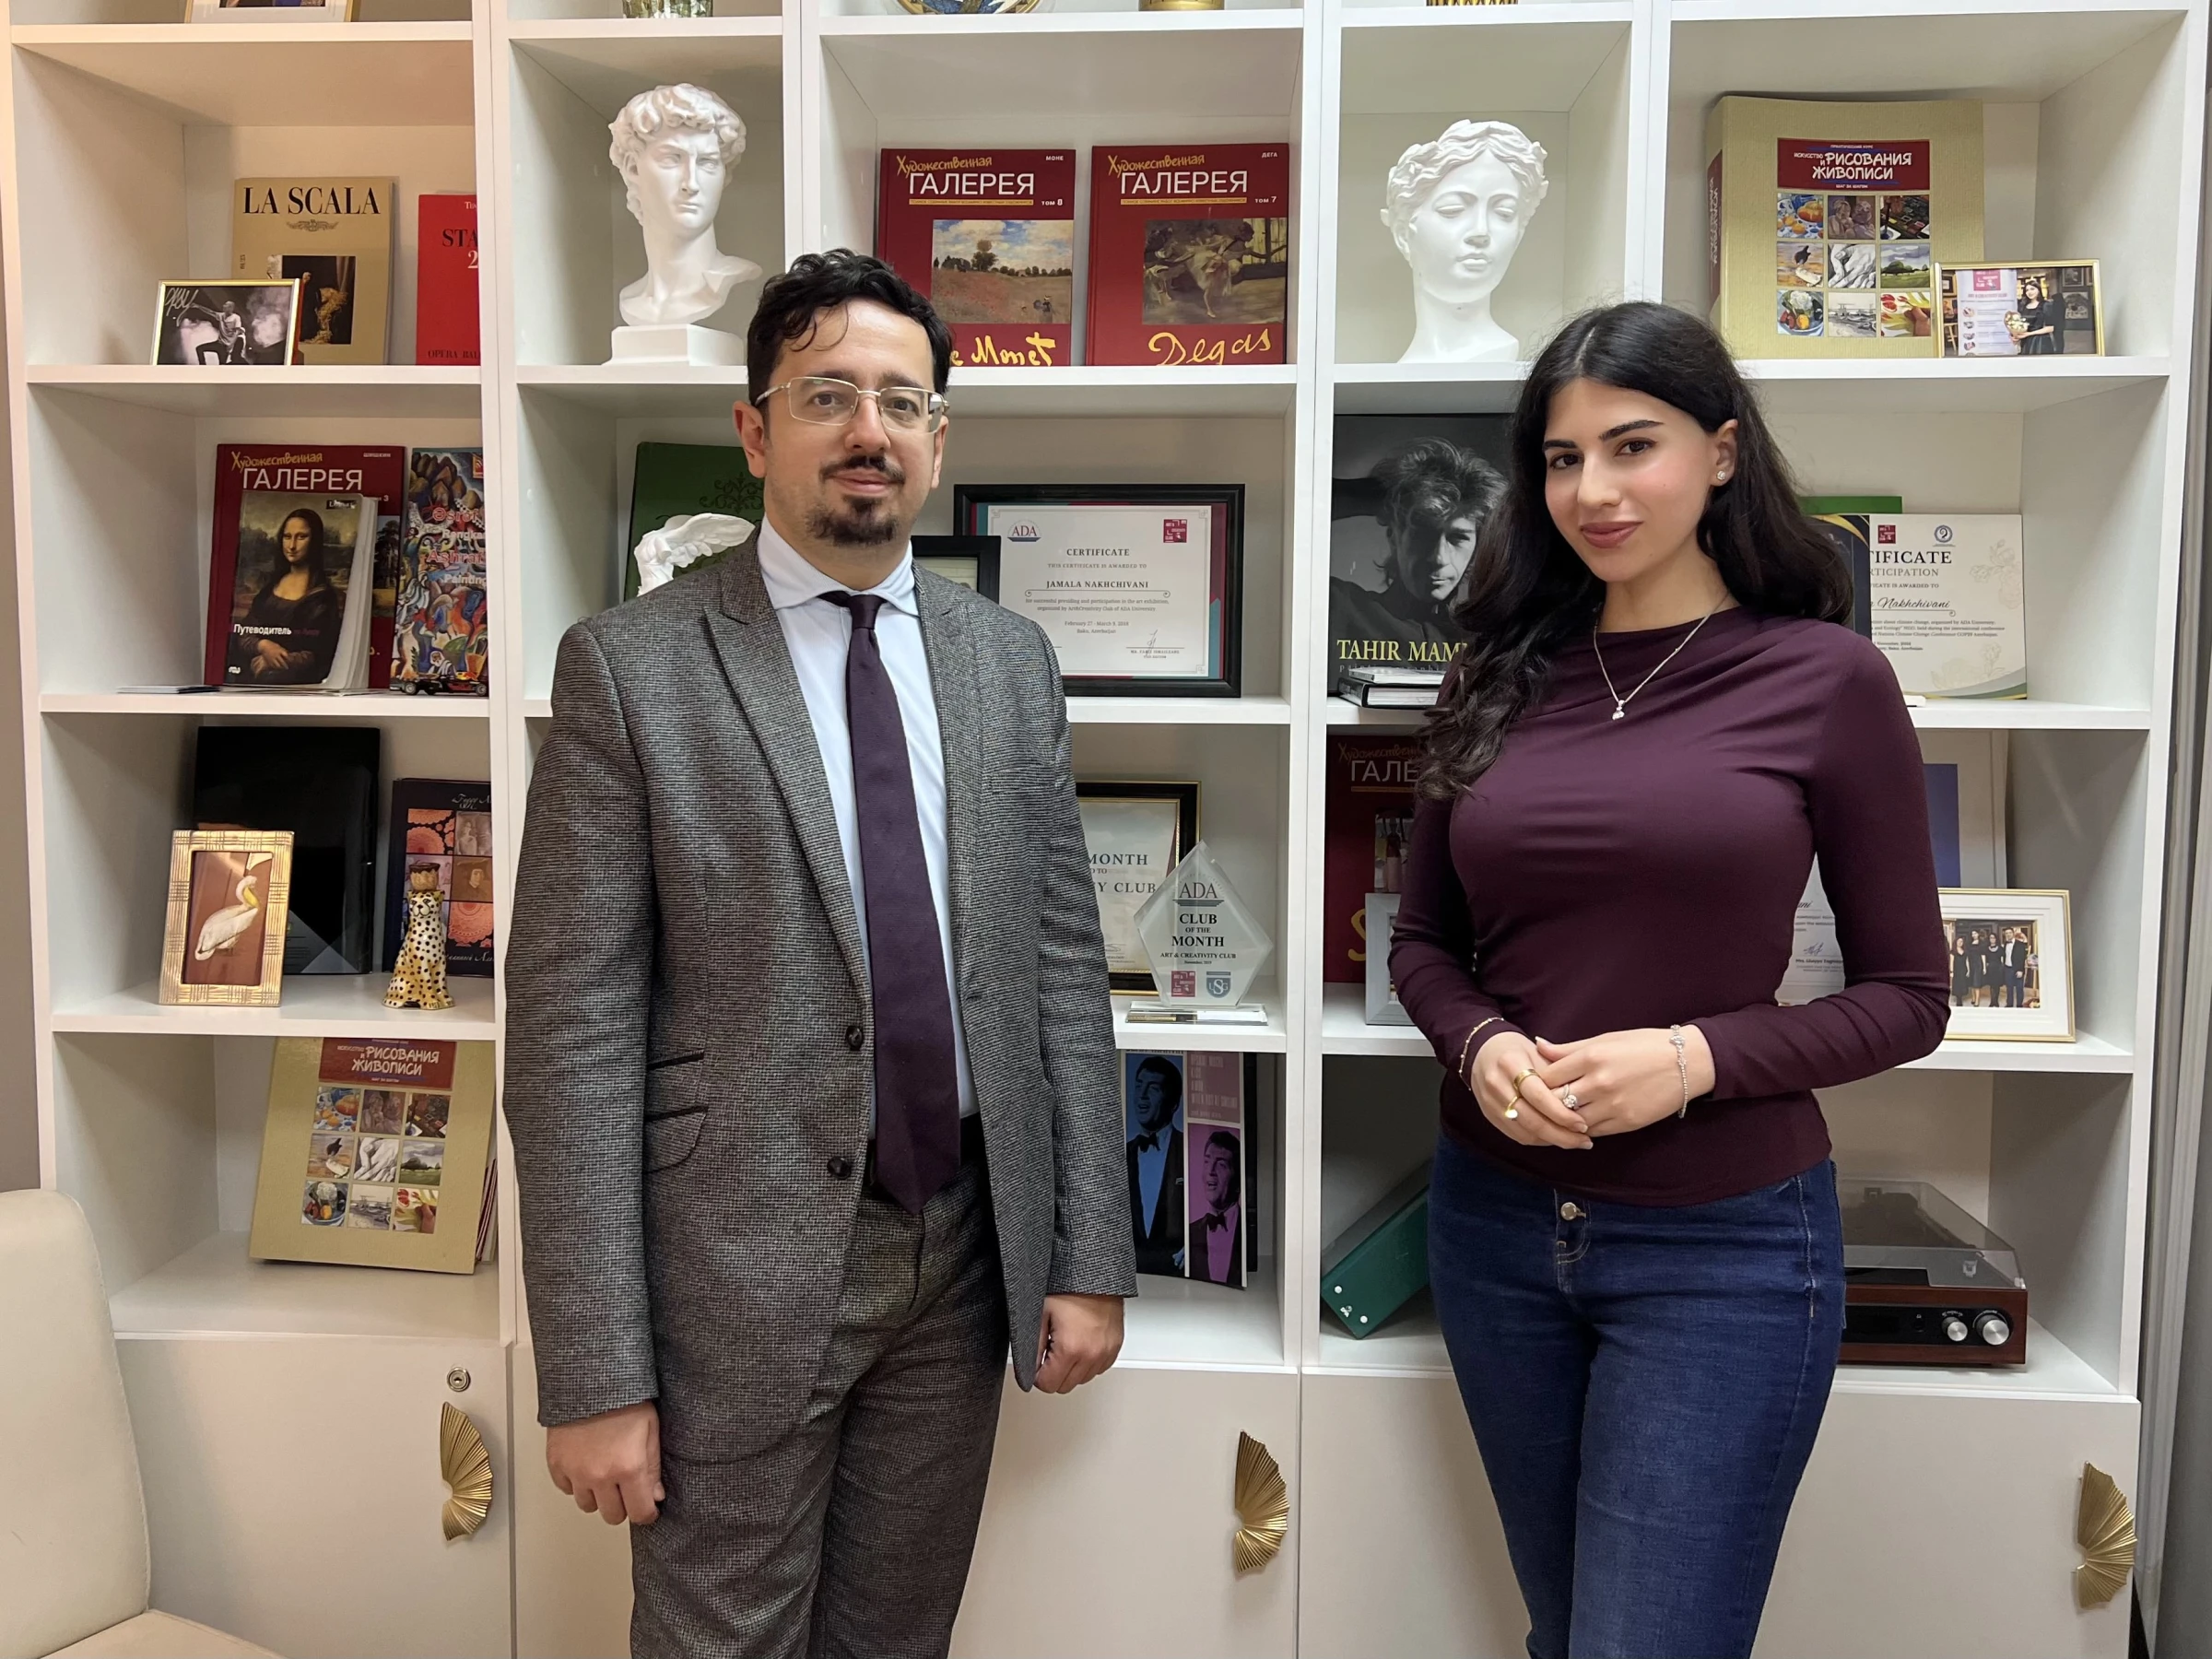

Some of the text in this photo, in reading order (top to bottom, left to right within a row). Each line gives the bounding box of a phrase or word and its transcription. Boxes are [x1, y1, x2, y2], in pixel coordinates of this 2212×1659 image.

[1825, 152, 1912, 166] РИСОВАНИЯ
[896, 155, 993, 179] Художественная
[1108, 154, 1206, 179] Художественная
[1812, 166, 1894, 180] ЖИВОПИСИ
[909, 172, 1035, 195] ГАЛЕРЕЯ
[1120, 171, 1248, 194] ГАЛЕРЕЯ
[242, 186, 381, 215] LA SCALA
[1057, 198, 1063, 206] 8
[1270, 195, 1277, 204] 7
[428, 349, 458, 359] OPERA
[231, 451, 323, 474] Художественная
[242, 468, 363, 490] ГАЛЕРЕЯ
[383, 494, 389, 502] 3
[1012, 524, 1037, 536] ADA
[1066, 548, 1131, 557] CERTIFICATE
[1046, 581, 1149, 589] JAMALA NAKHCHIVANI
[1877, 597, 1950, 608] Nakhchivani
[233, 624, 292, 636] Путеводитель
[1336, 639, 1468, 662] TAHIR MAM
[1351, 759, 1419, 782] ГАЛЕ
[1113, 882, 1157, 893] CLUB
[1179, 882, 1218, 899] ADA
[1179, 913, 1218, 924] CLUB
[1171, 935, 1225, 947] MONTH
[365, 1046, 440, 1064] РИСОВАНИЯ
[351, 1059, 423, 1076] ЖИВОПИСИ
